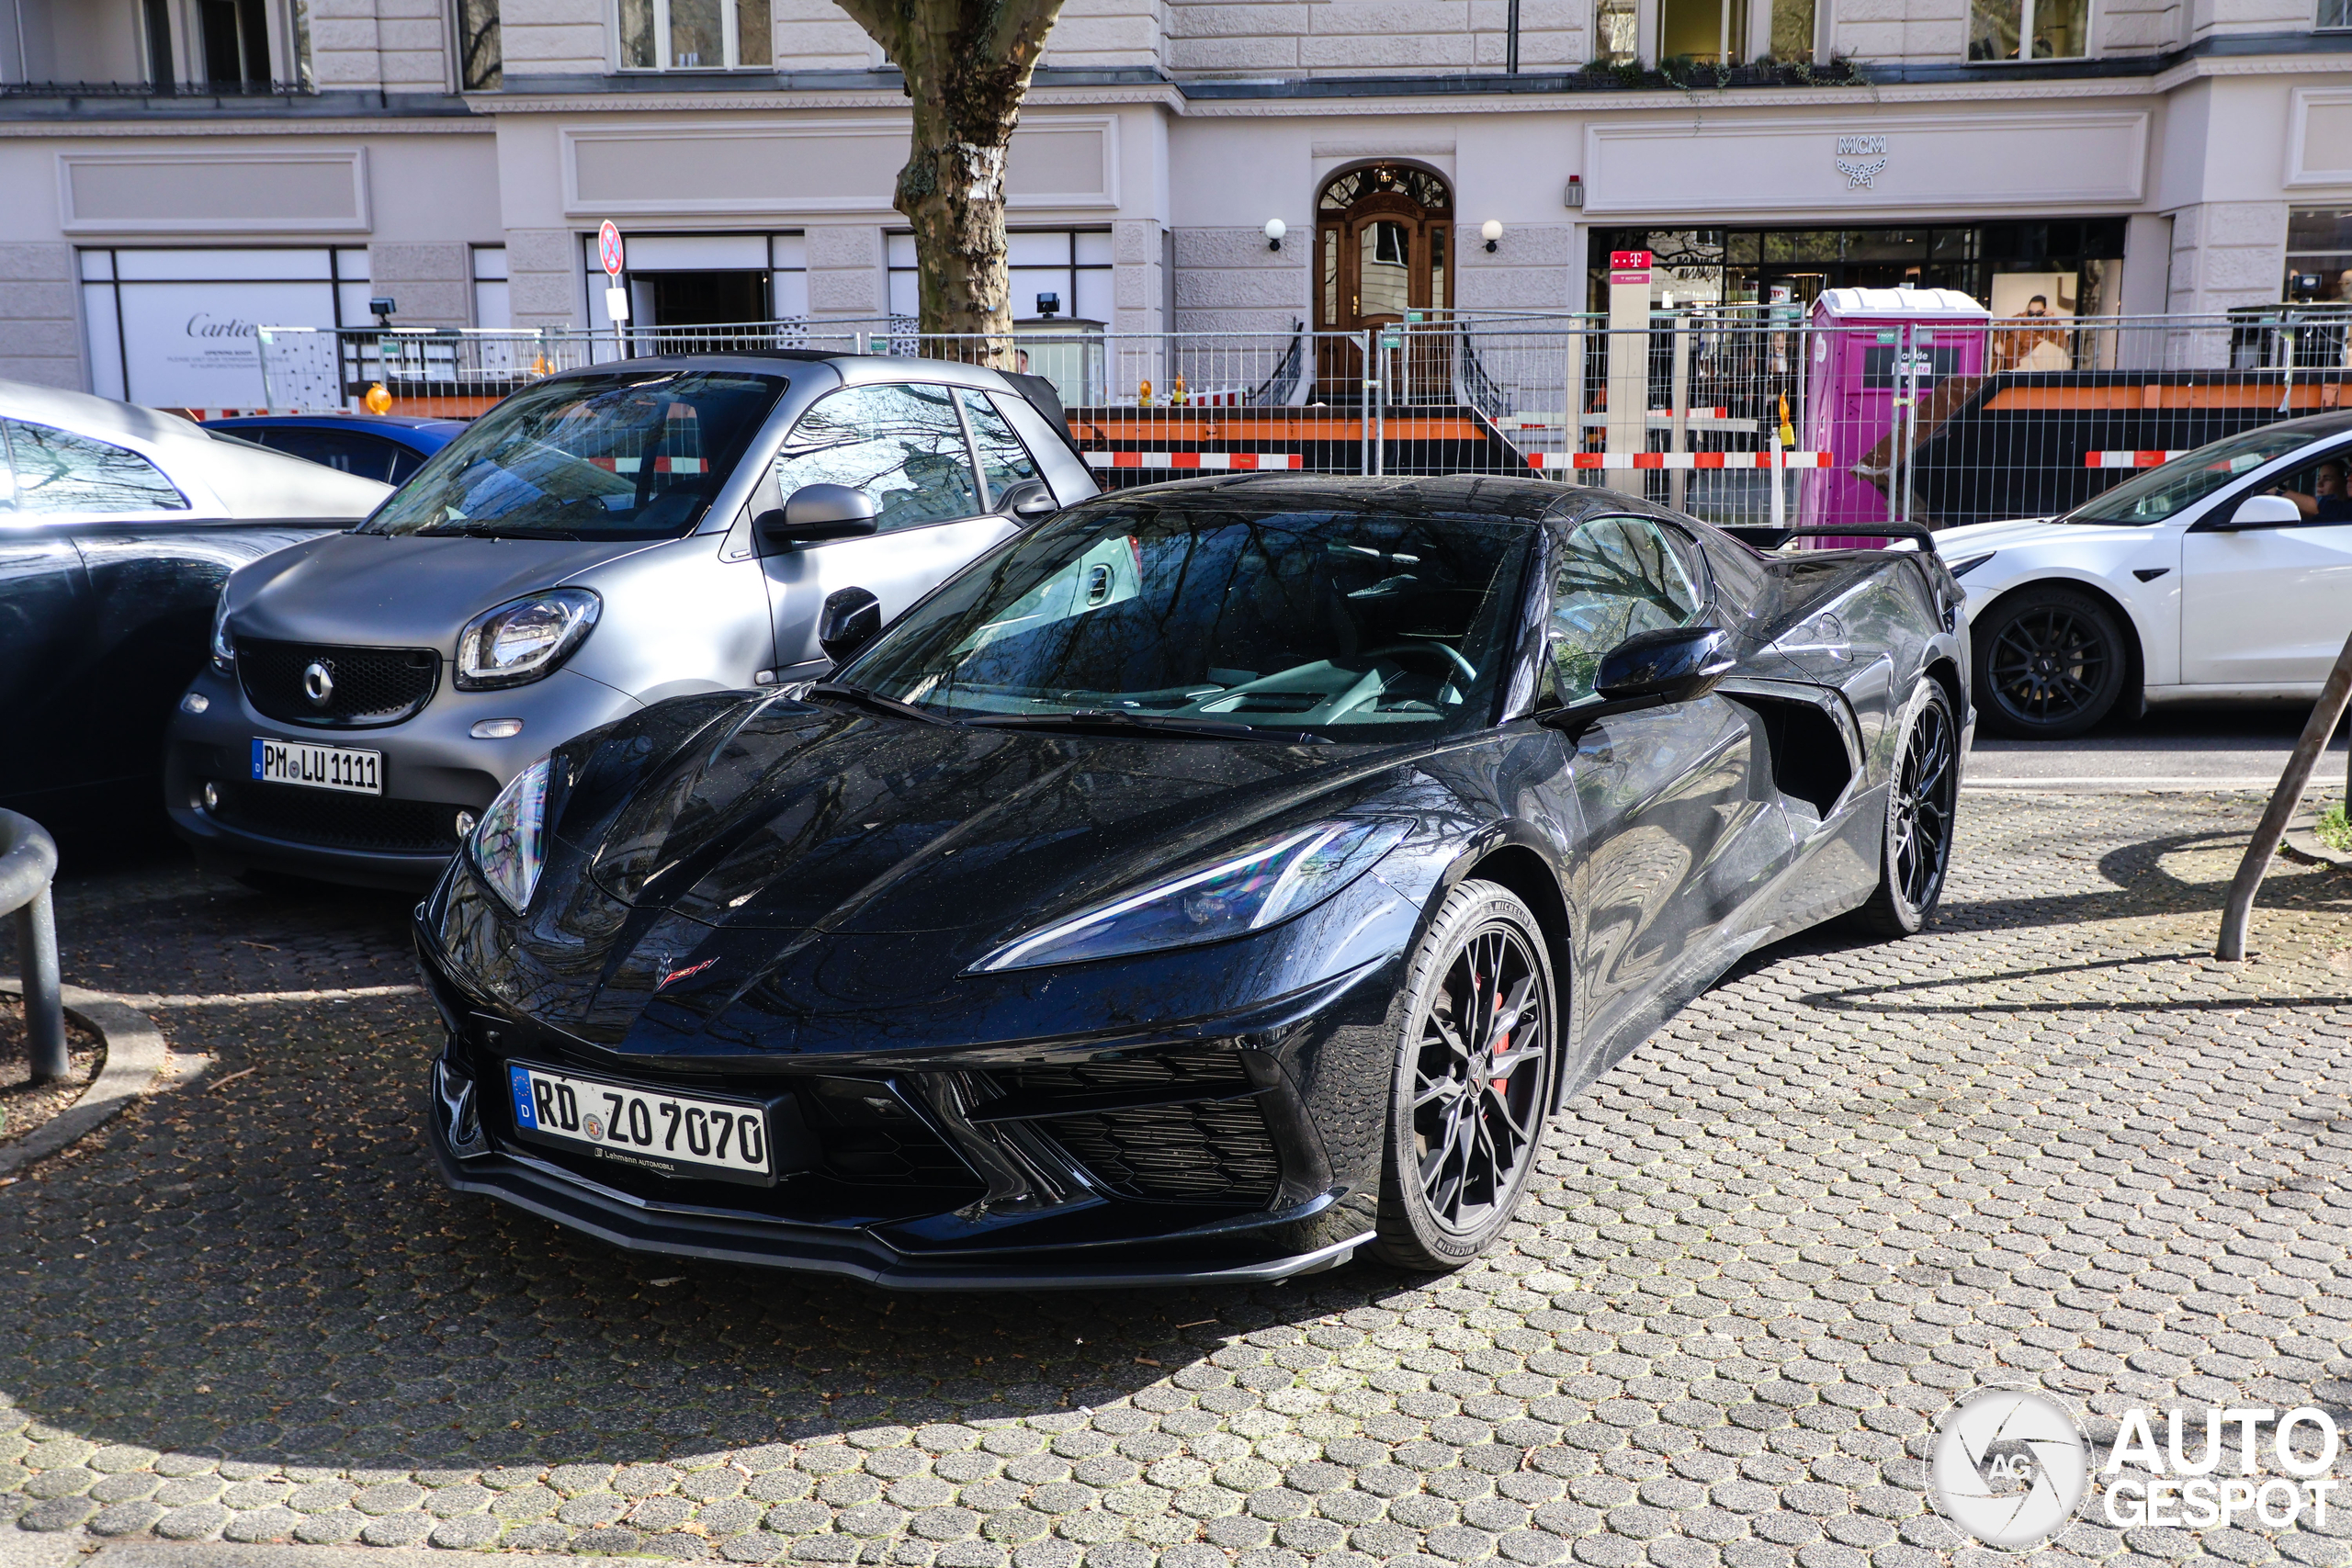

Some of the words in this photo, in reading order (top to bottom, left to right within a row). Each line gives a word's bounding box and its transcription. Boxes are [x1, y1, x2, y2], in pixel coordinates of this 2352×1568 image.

[1838, 135, 1886, 154] MCM
[265, 745, 287, 778] PM
[301, 749, 325, 783] LU
[332, 752, 378, 788] 1111
[1494, 901, 1530, 925] MICHELIN
[532, 1077, 579, 1132] RD
[603, 1092, 652, 1146] ZO
[660, 1102, 763, 1164] 7070
[605, 1150, 638, 1164] Lehmann
[638, 1159, 675, 1171] AUTOMOBILE
[1436, 1239, 1476, 1257] MICHELIN
